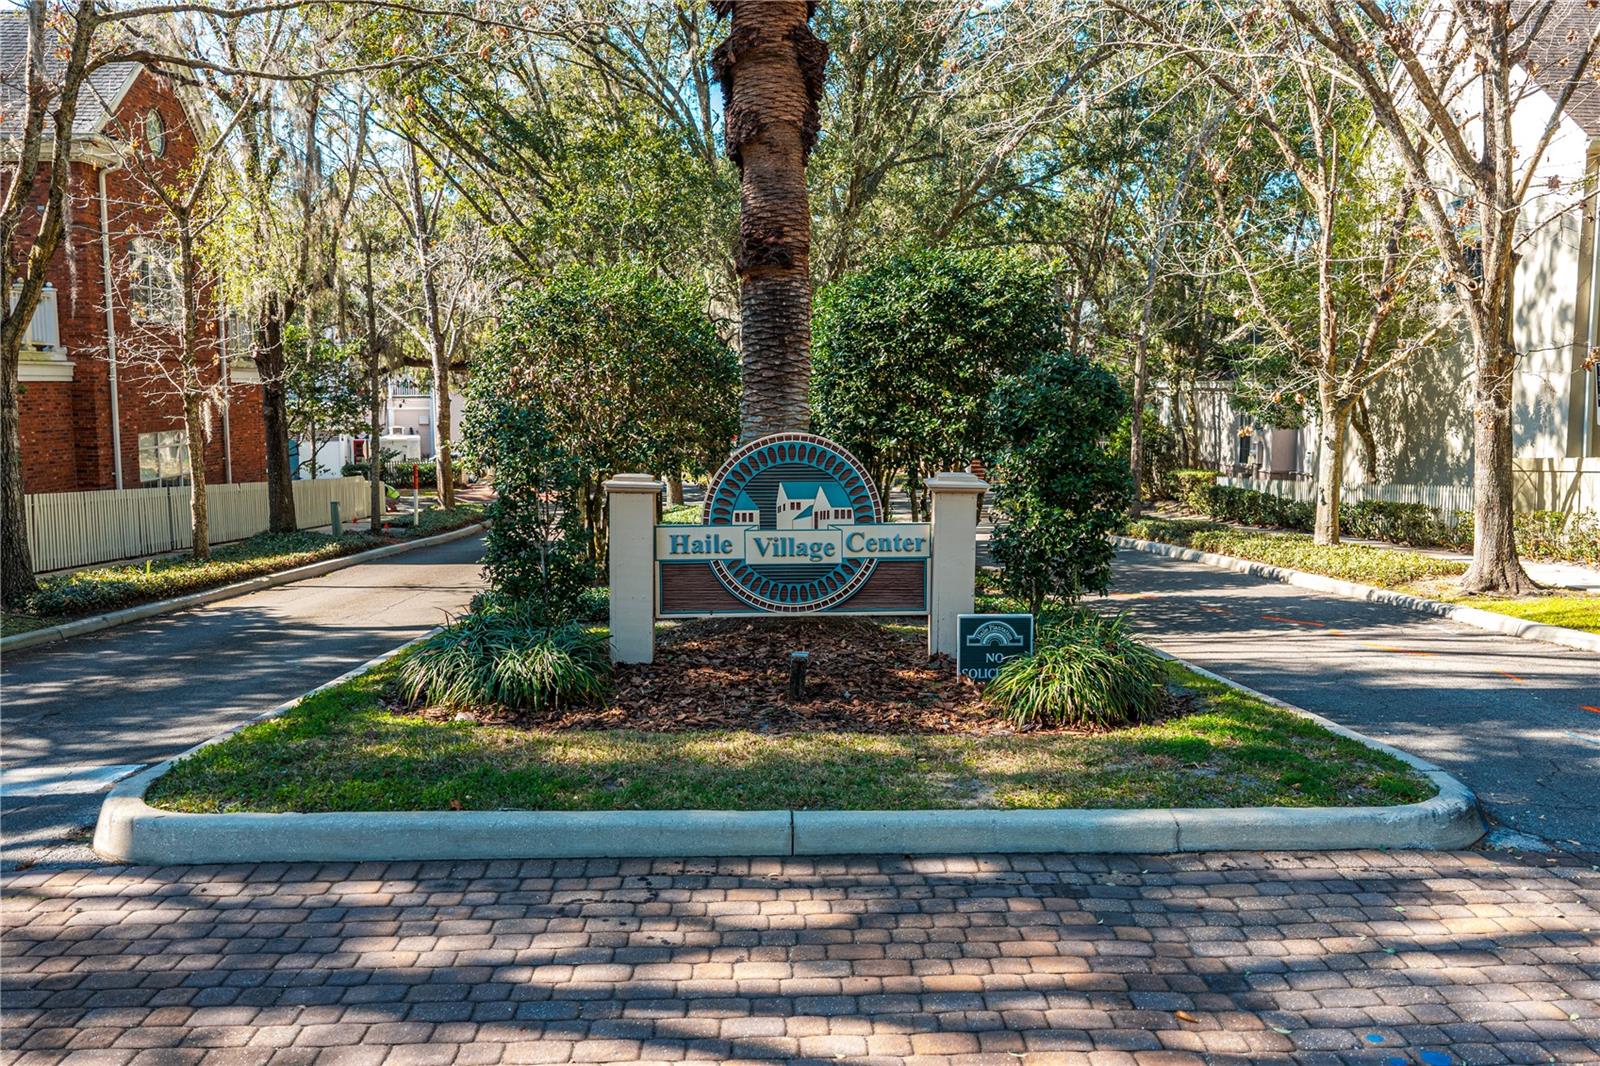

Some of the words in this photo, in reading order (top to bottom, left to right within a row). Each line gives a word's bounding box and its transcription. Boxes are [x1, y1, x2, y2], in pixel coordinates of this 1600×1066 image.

[669, 533, 734, 555] Haile
[752, 536, 837, 563] Village
[845, 531, 927, 554] Center
[986, 653, 1004, 664] NO
